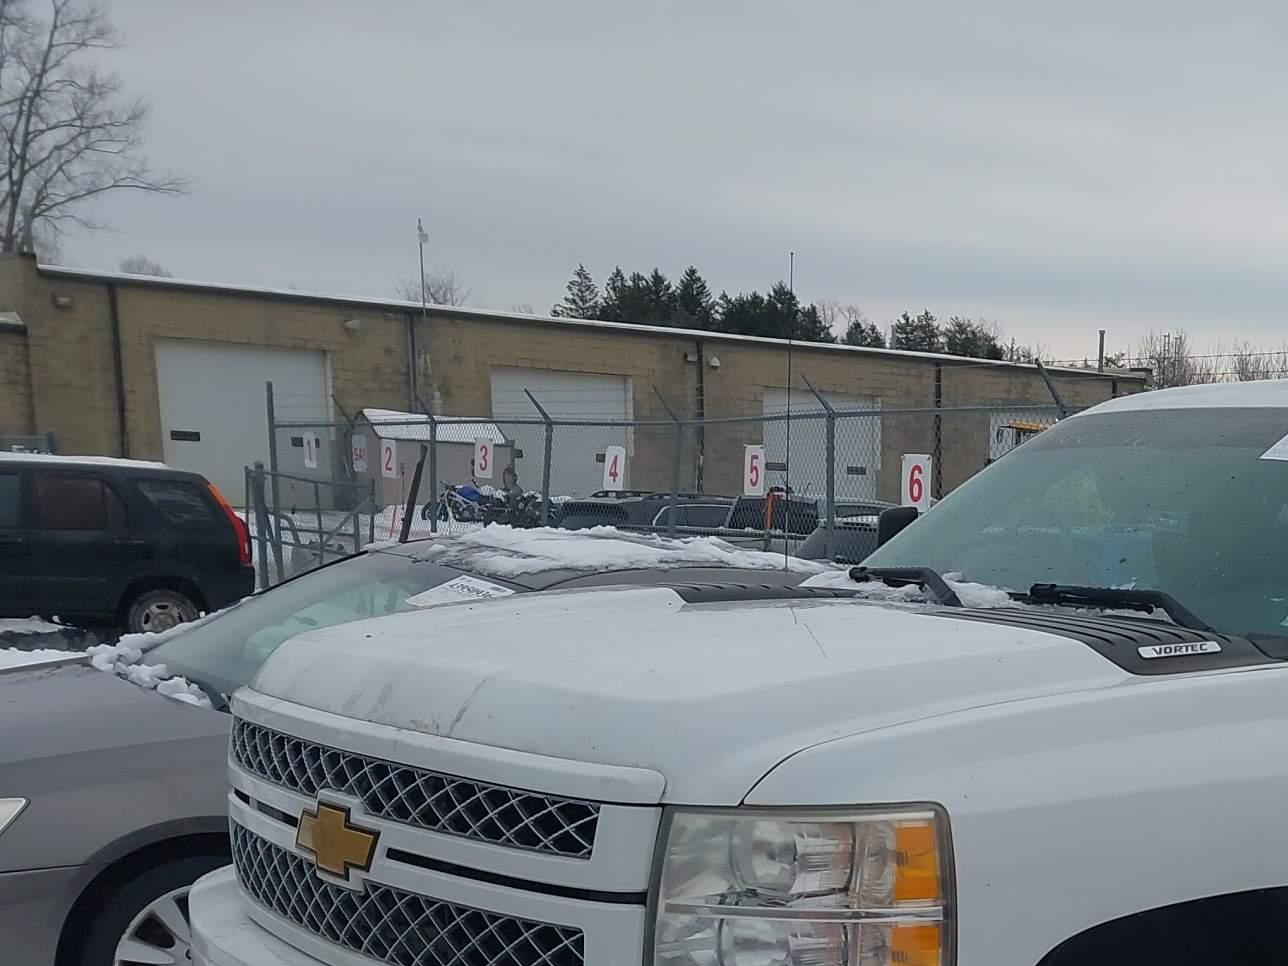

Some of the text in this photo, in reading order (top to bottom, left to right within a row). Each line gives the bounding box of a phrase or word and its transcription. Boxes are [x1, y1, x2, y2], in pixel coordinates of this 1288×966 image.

[384, 446, 393, 471] 2
[479, 444, 488, 471] 3
[608, 454, 618, 482] 4
[749, 454, 759, 487] 5
[908, 464, 923, 503] 6
[1151, 642, 1208, 655] VORTEC
